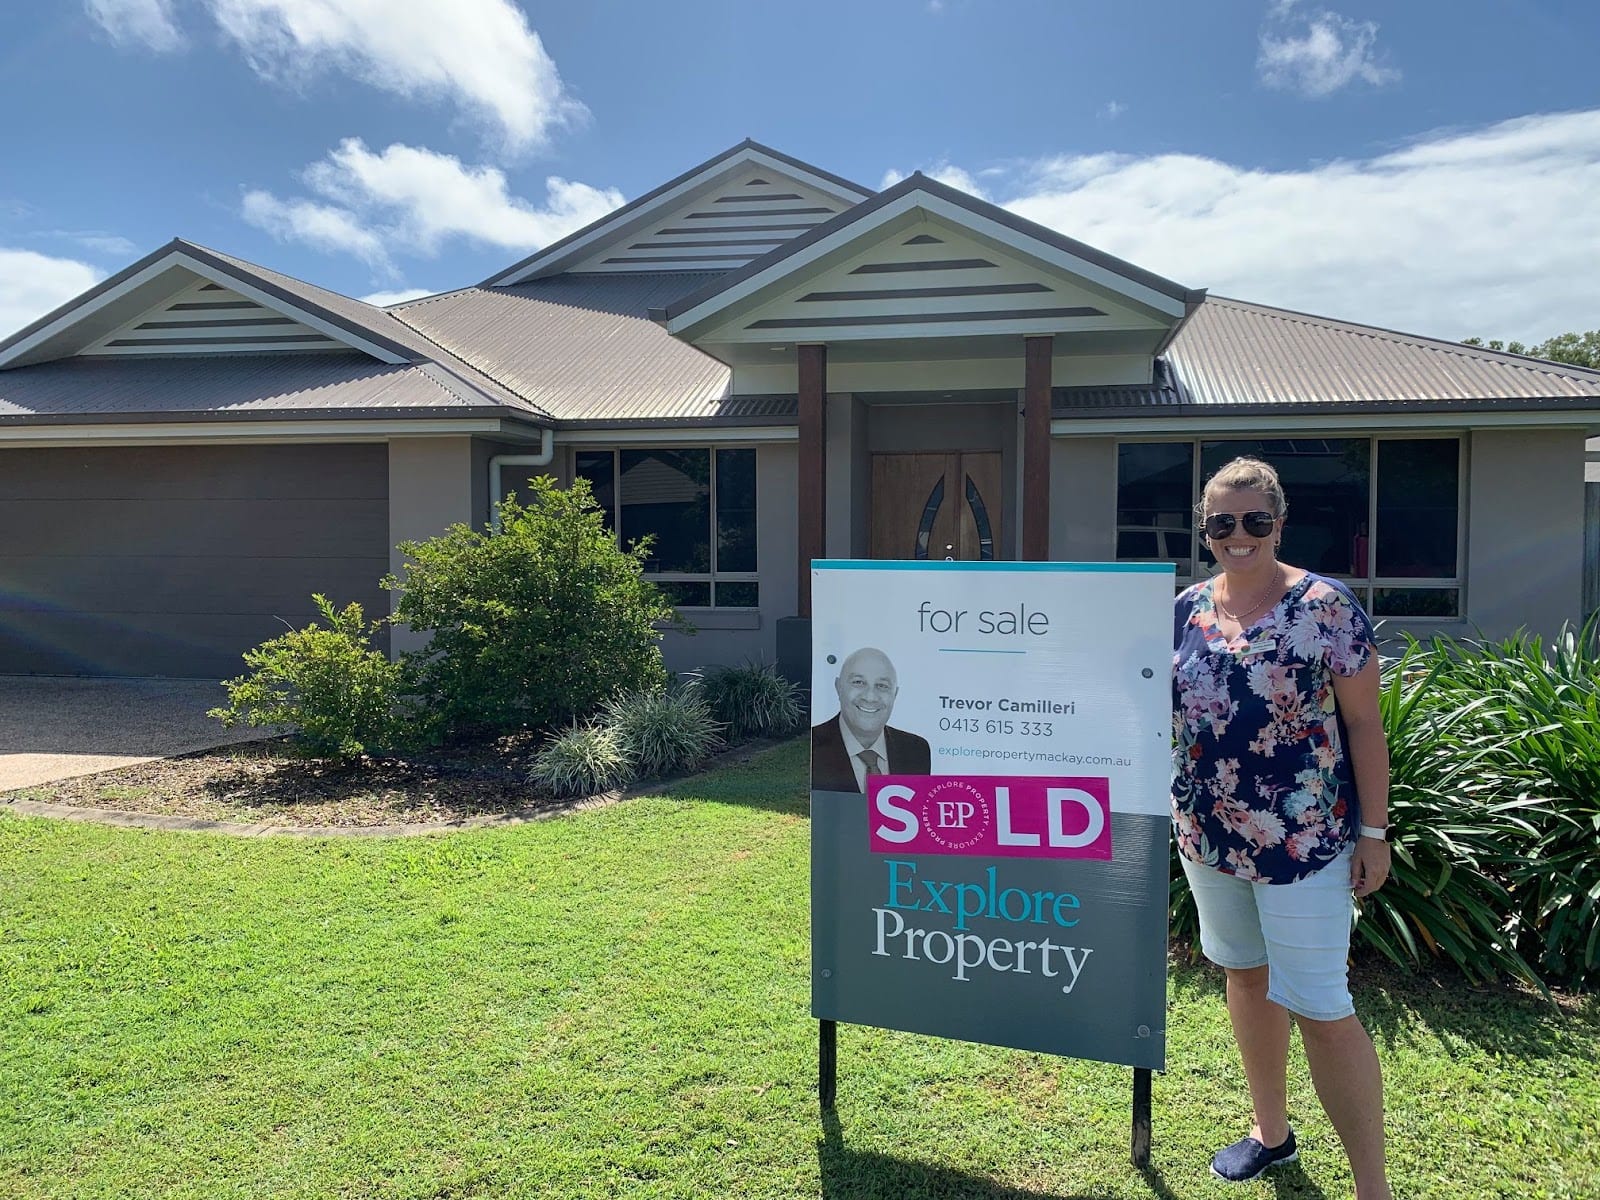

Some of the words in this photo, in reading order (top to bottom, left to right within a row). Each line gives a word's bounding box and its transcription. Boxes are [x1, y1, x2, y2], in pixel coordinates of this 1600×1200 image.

[917, 601, 967, 633] for
[978, 603, 1049, 635] sale
[939, 695, 993, 711] Trevor
[998, 699, 1075, 715] Camilleri
[939, 716, 980, 733] 0413
[986, 719, 1014, 735] 615
[1021, 721, 1053, 737] 333
[938, 745, 1132, 767] explorepropertymackay.com.au
[936, 801, 975, 828] EP
[884, 860, 1081, 931] Explore
[871, 908, 1094, 994] Property
